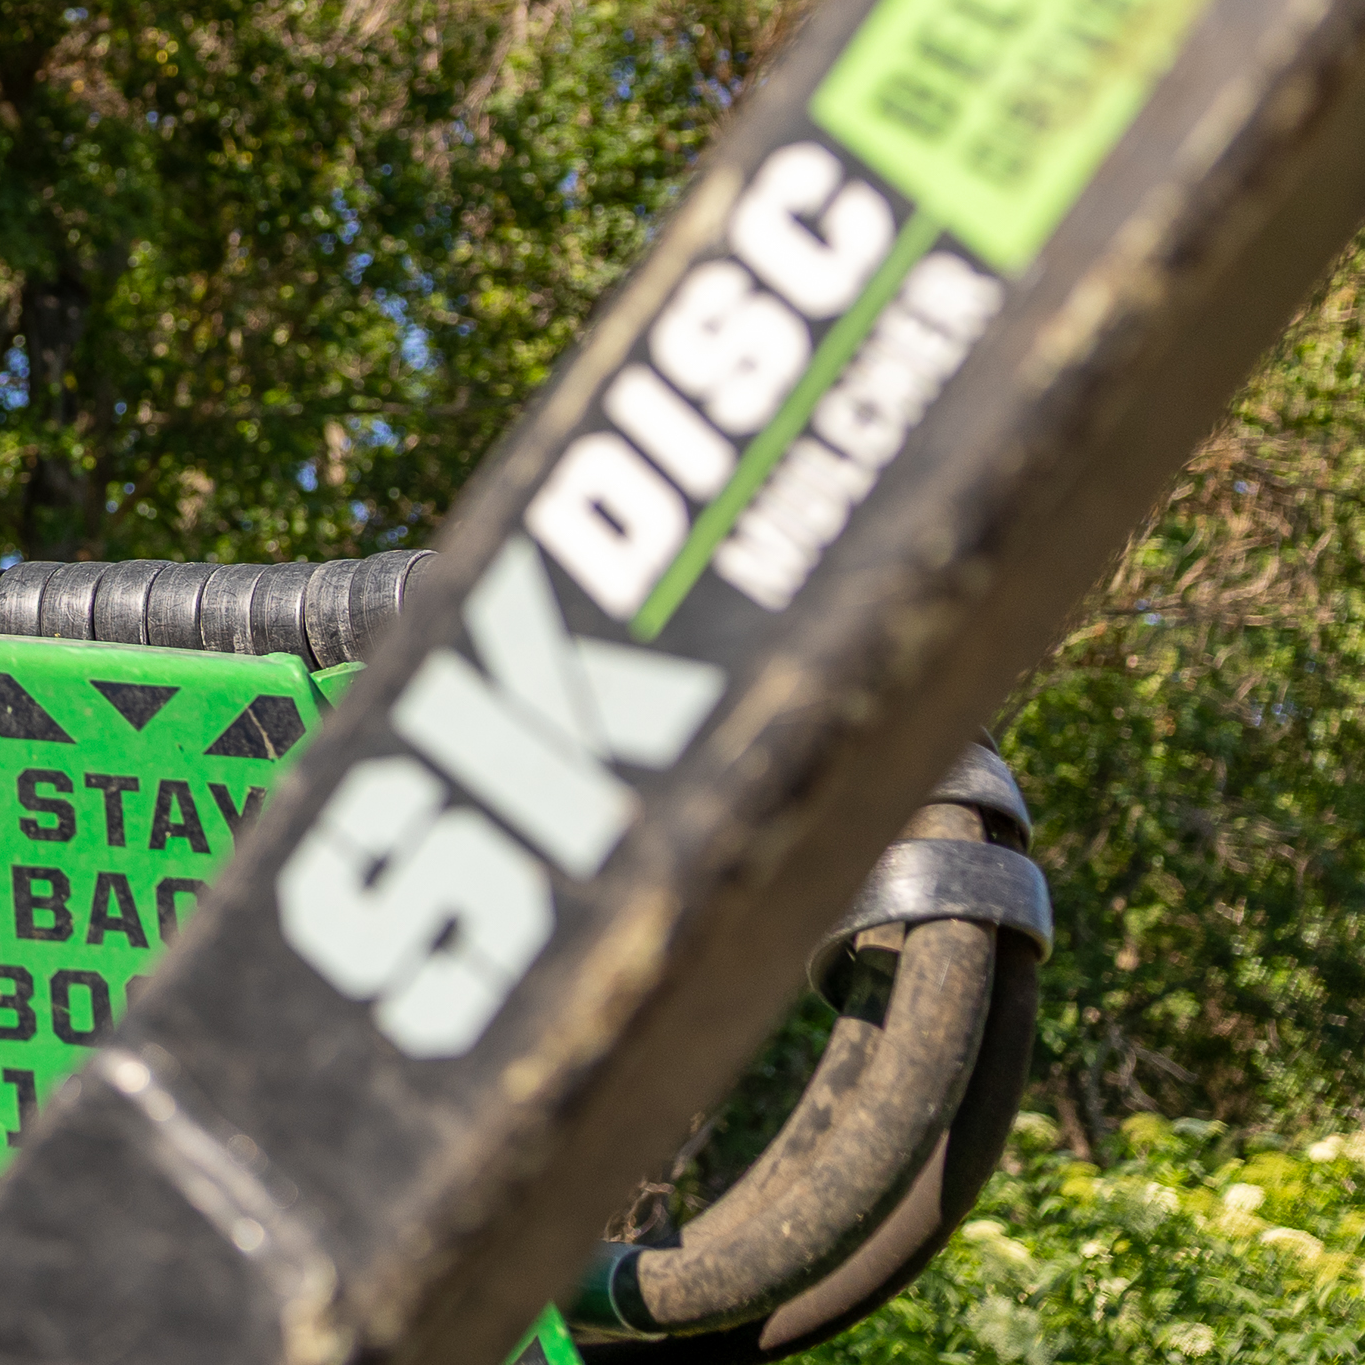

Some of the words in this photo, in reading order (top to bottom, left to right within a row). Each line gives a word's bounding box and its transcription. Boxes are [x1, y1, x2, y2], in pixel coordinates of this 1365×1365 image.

[523, 141, 897, 623] DISC
[713, 251, 1007, 612] MULCHER
[274, 534, 729, 1061] SK
